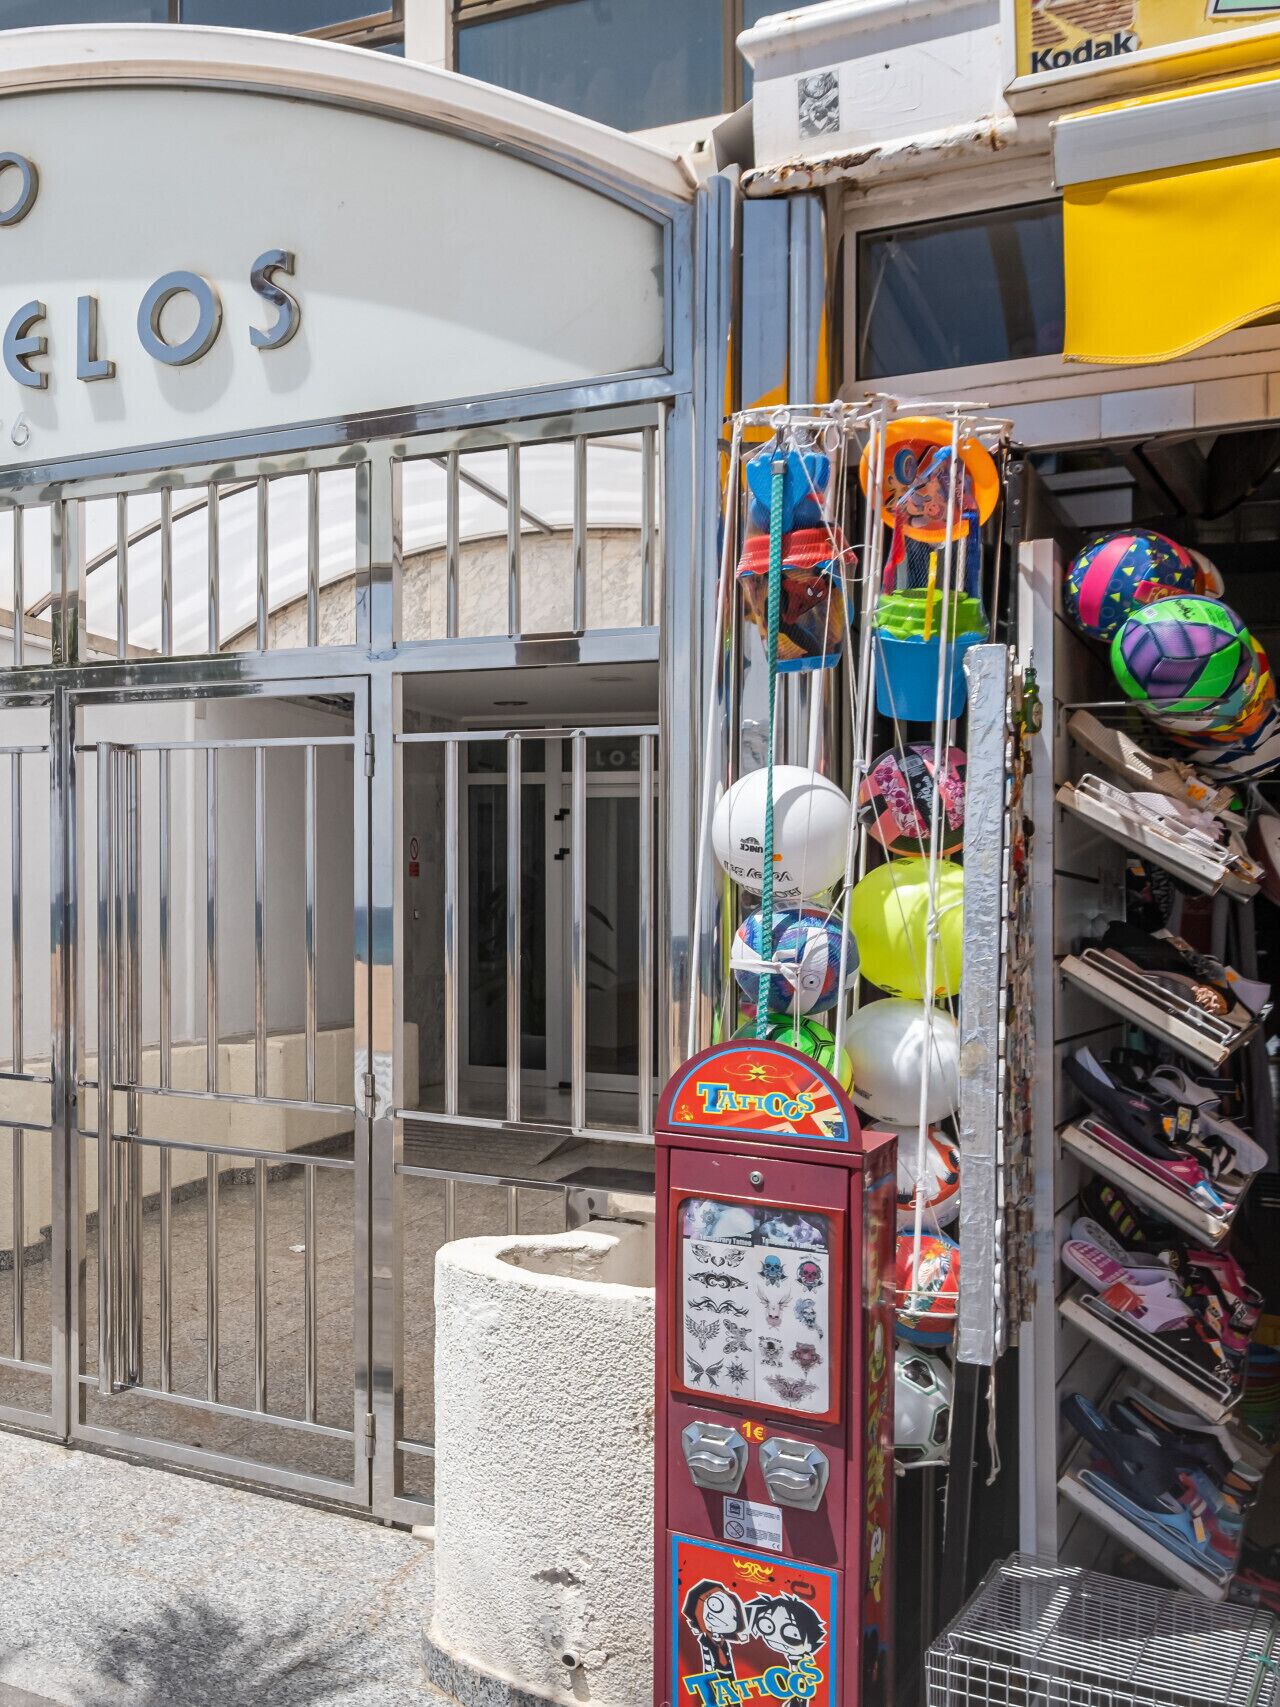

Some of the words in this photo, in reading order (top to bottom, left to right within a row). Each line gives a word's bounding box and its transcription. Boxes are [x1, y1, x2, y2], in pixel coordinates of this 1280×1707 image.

[1031, 32, 1134, 74] Kodak
[10, 412, 31, 447] 6
[596, 750, 640, 767] LOS
[742, 1421, 764, 1441] 1€
